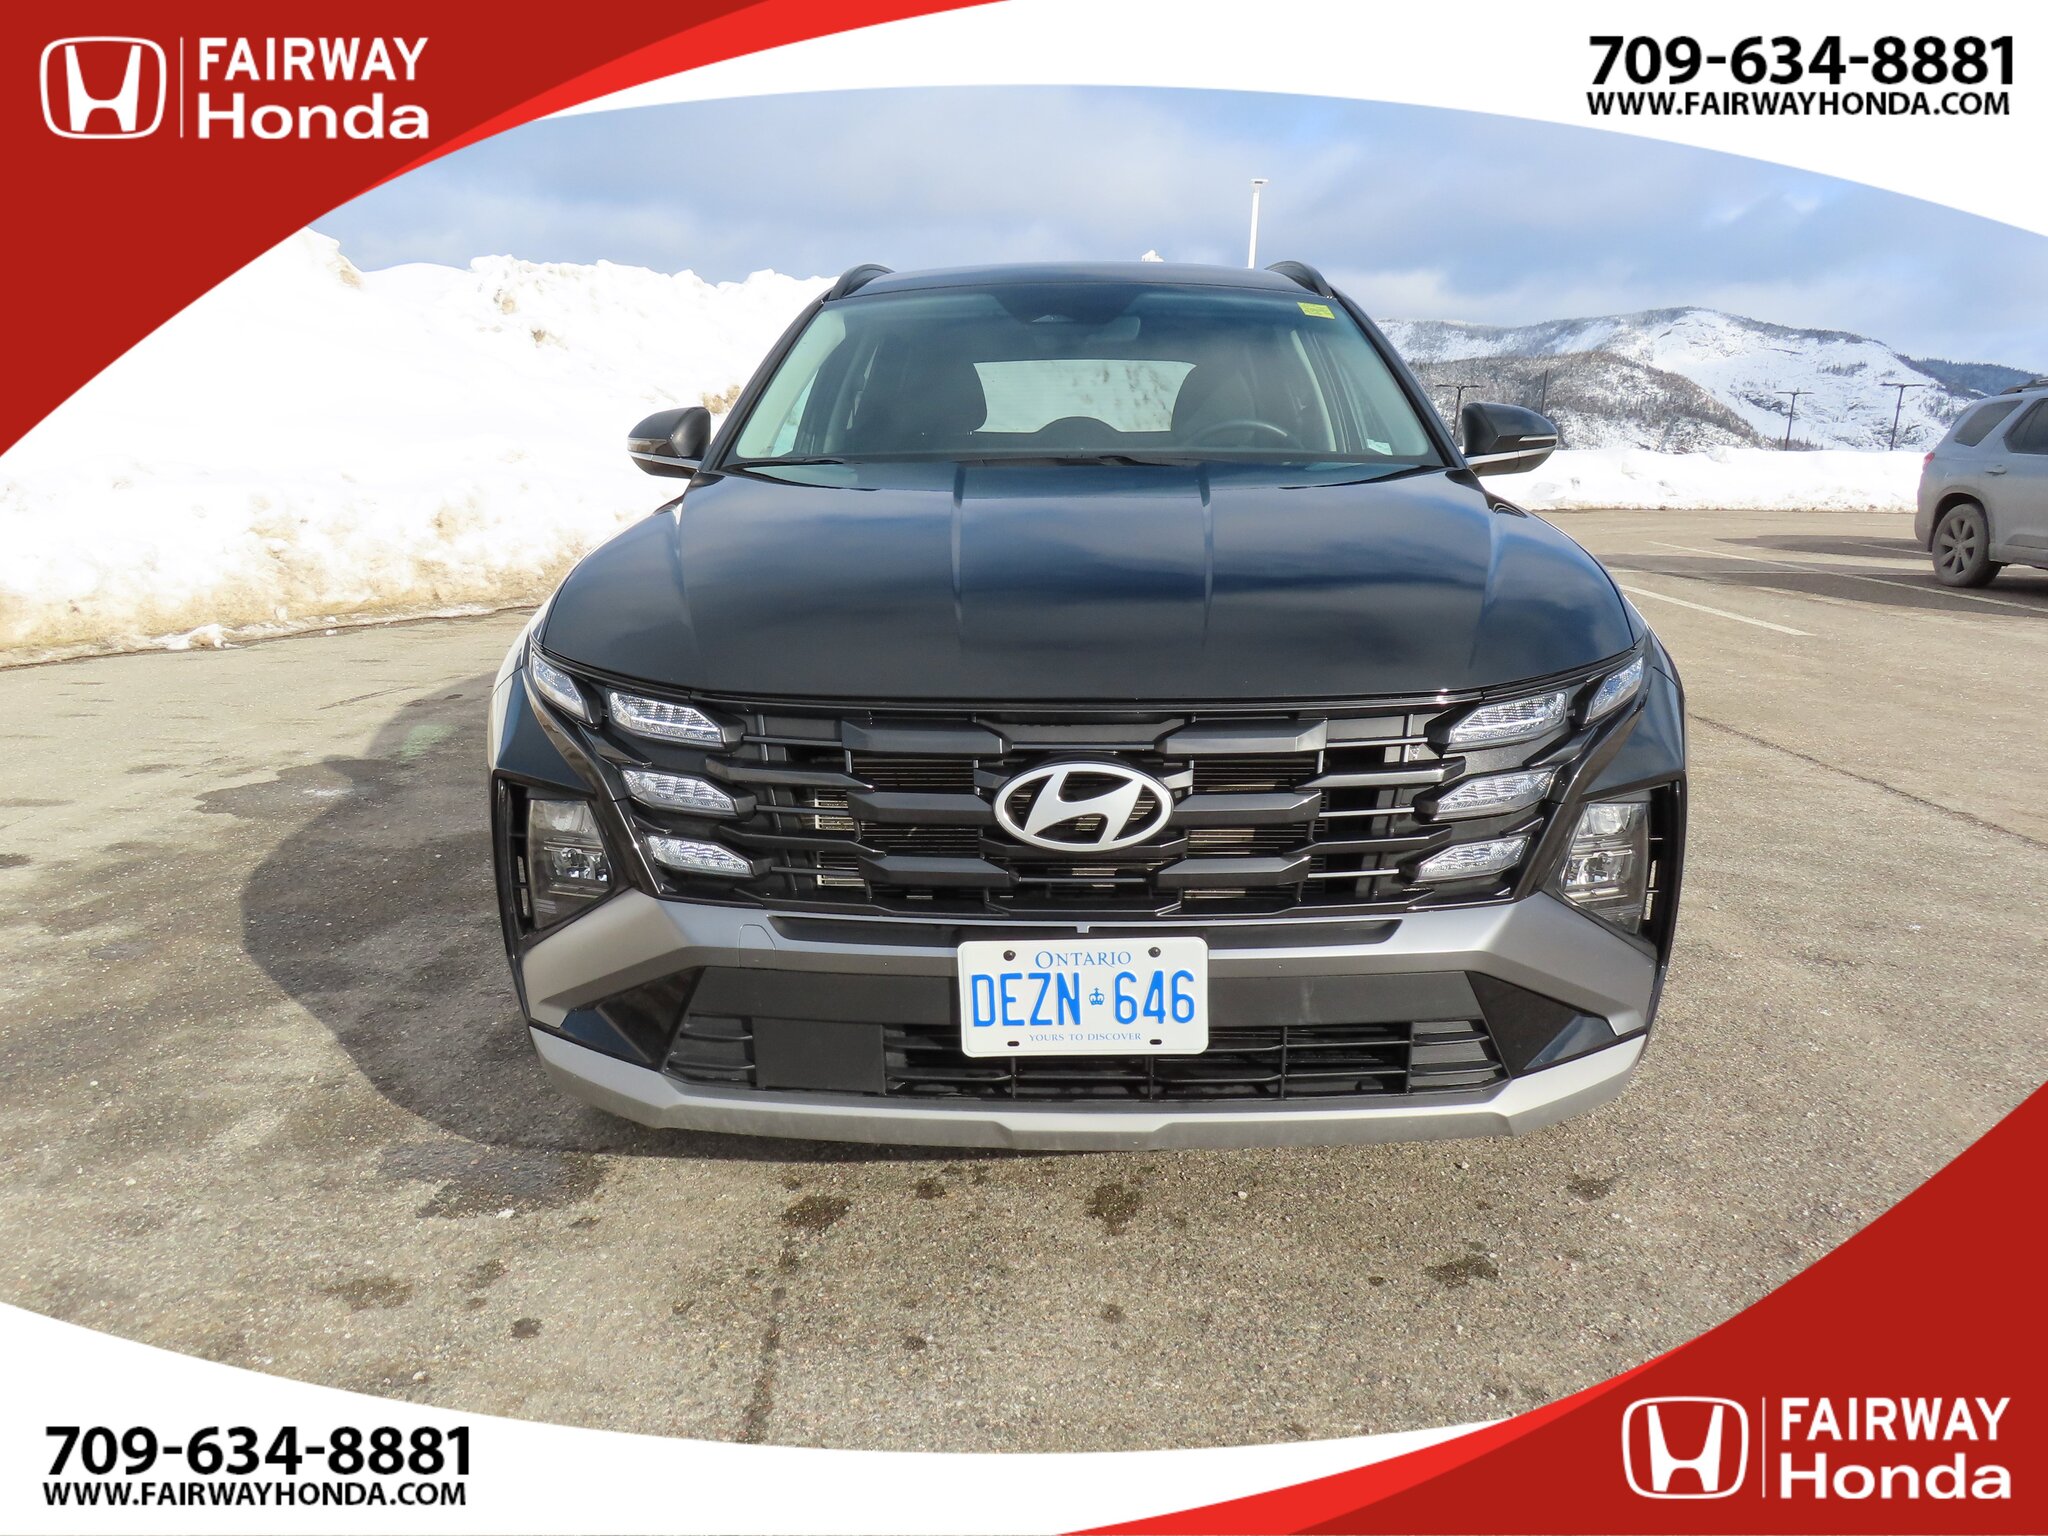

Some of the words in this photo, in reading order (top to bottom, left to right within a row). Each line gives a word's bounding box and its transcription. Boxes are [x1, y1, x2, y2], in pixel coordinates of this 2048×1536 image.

[970, 972, 1081, 1027] DEZN
[1113, 969, 1195, 1025] 646
[1029, 1033, 1065, 1042] YOURS
[1069, 1033, 1084, 1041] TO
[1087, 1032, 1142, 1041] DISCOVER
